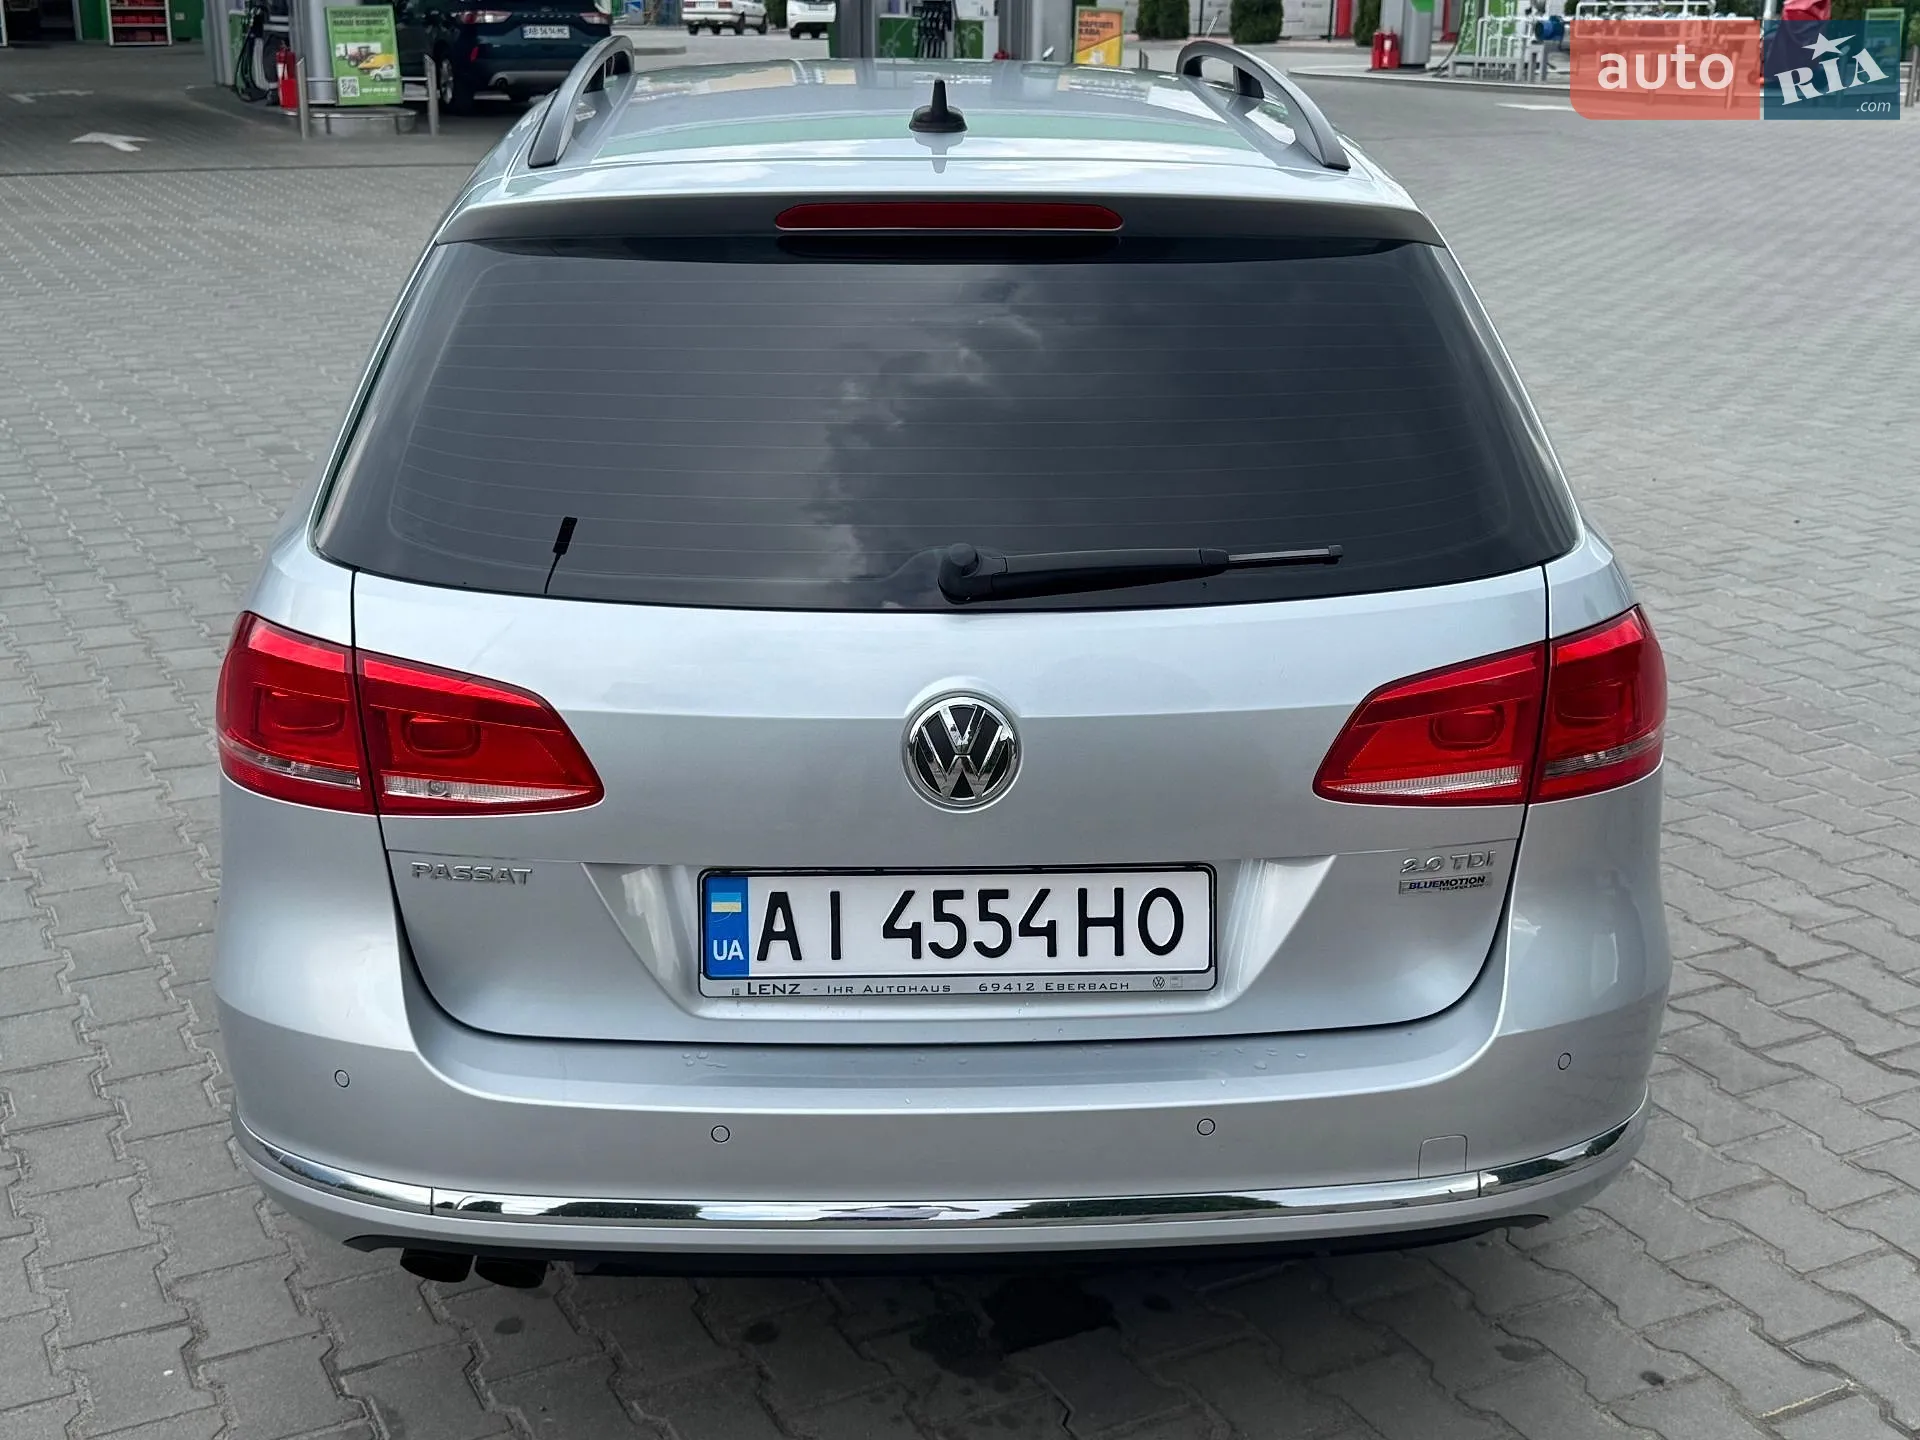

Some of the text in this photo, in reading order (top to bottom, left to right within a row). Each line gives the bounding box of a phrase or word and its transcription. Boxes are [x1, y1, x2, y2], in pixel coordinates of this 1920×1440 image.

[1401, 850, 1497, 873] 2.0 TDI
[410, 861, 533, 885] PASSAT
[1408, 875, 1486, 890] BLUEMOTION
[712, 940, 745, 961] UA
[747, 981, 801, 995] LENZ
[979, 982, 1035, 992] 69412
